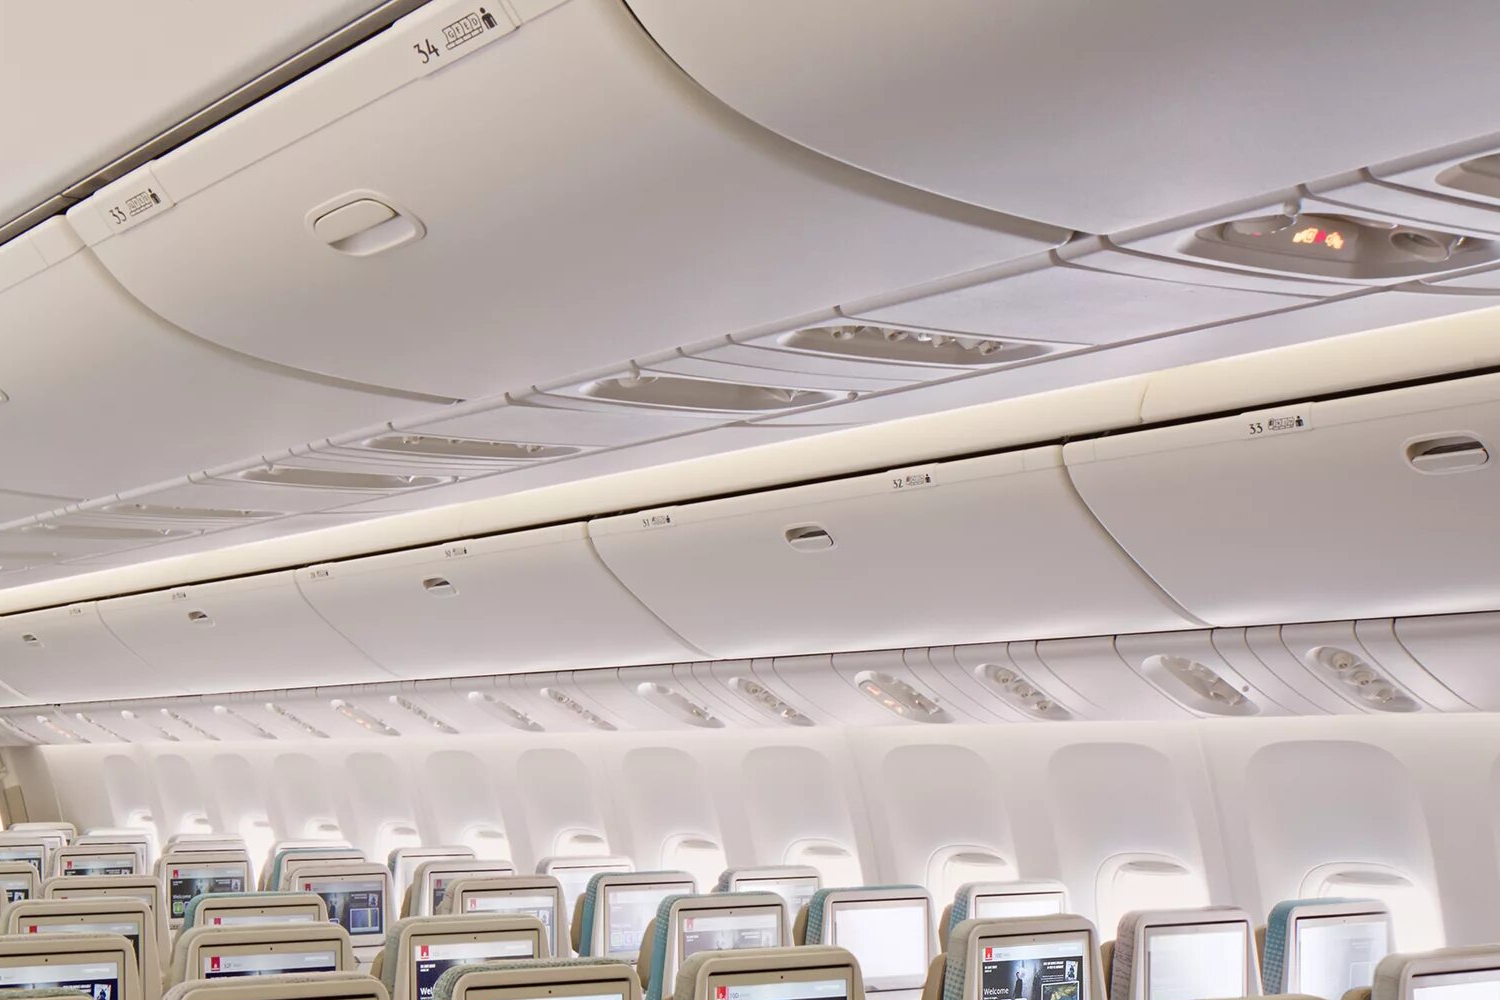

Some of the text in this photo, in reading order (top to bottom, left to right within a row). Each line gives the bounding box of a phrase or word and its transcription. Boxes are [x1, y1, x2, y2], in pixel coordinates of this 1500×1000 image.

[413, 38, 440, 64] 34
[109, 206, 127, 224] 33
[1249, 422, 1263, 434] 33
